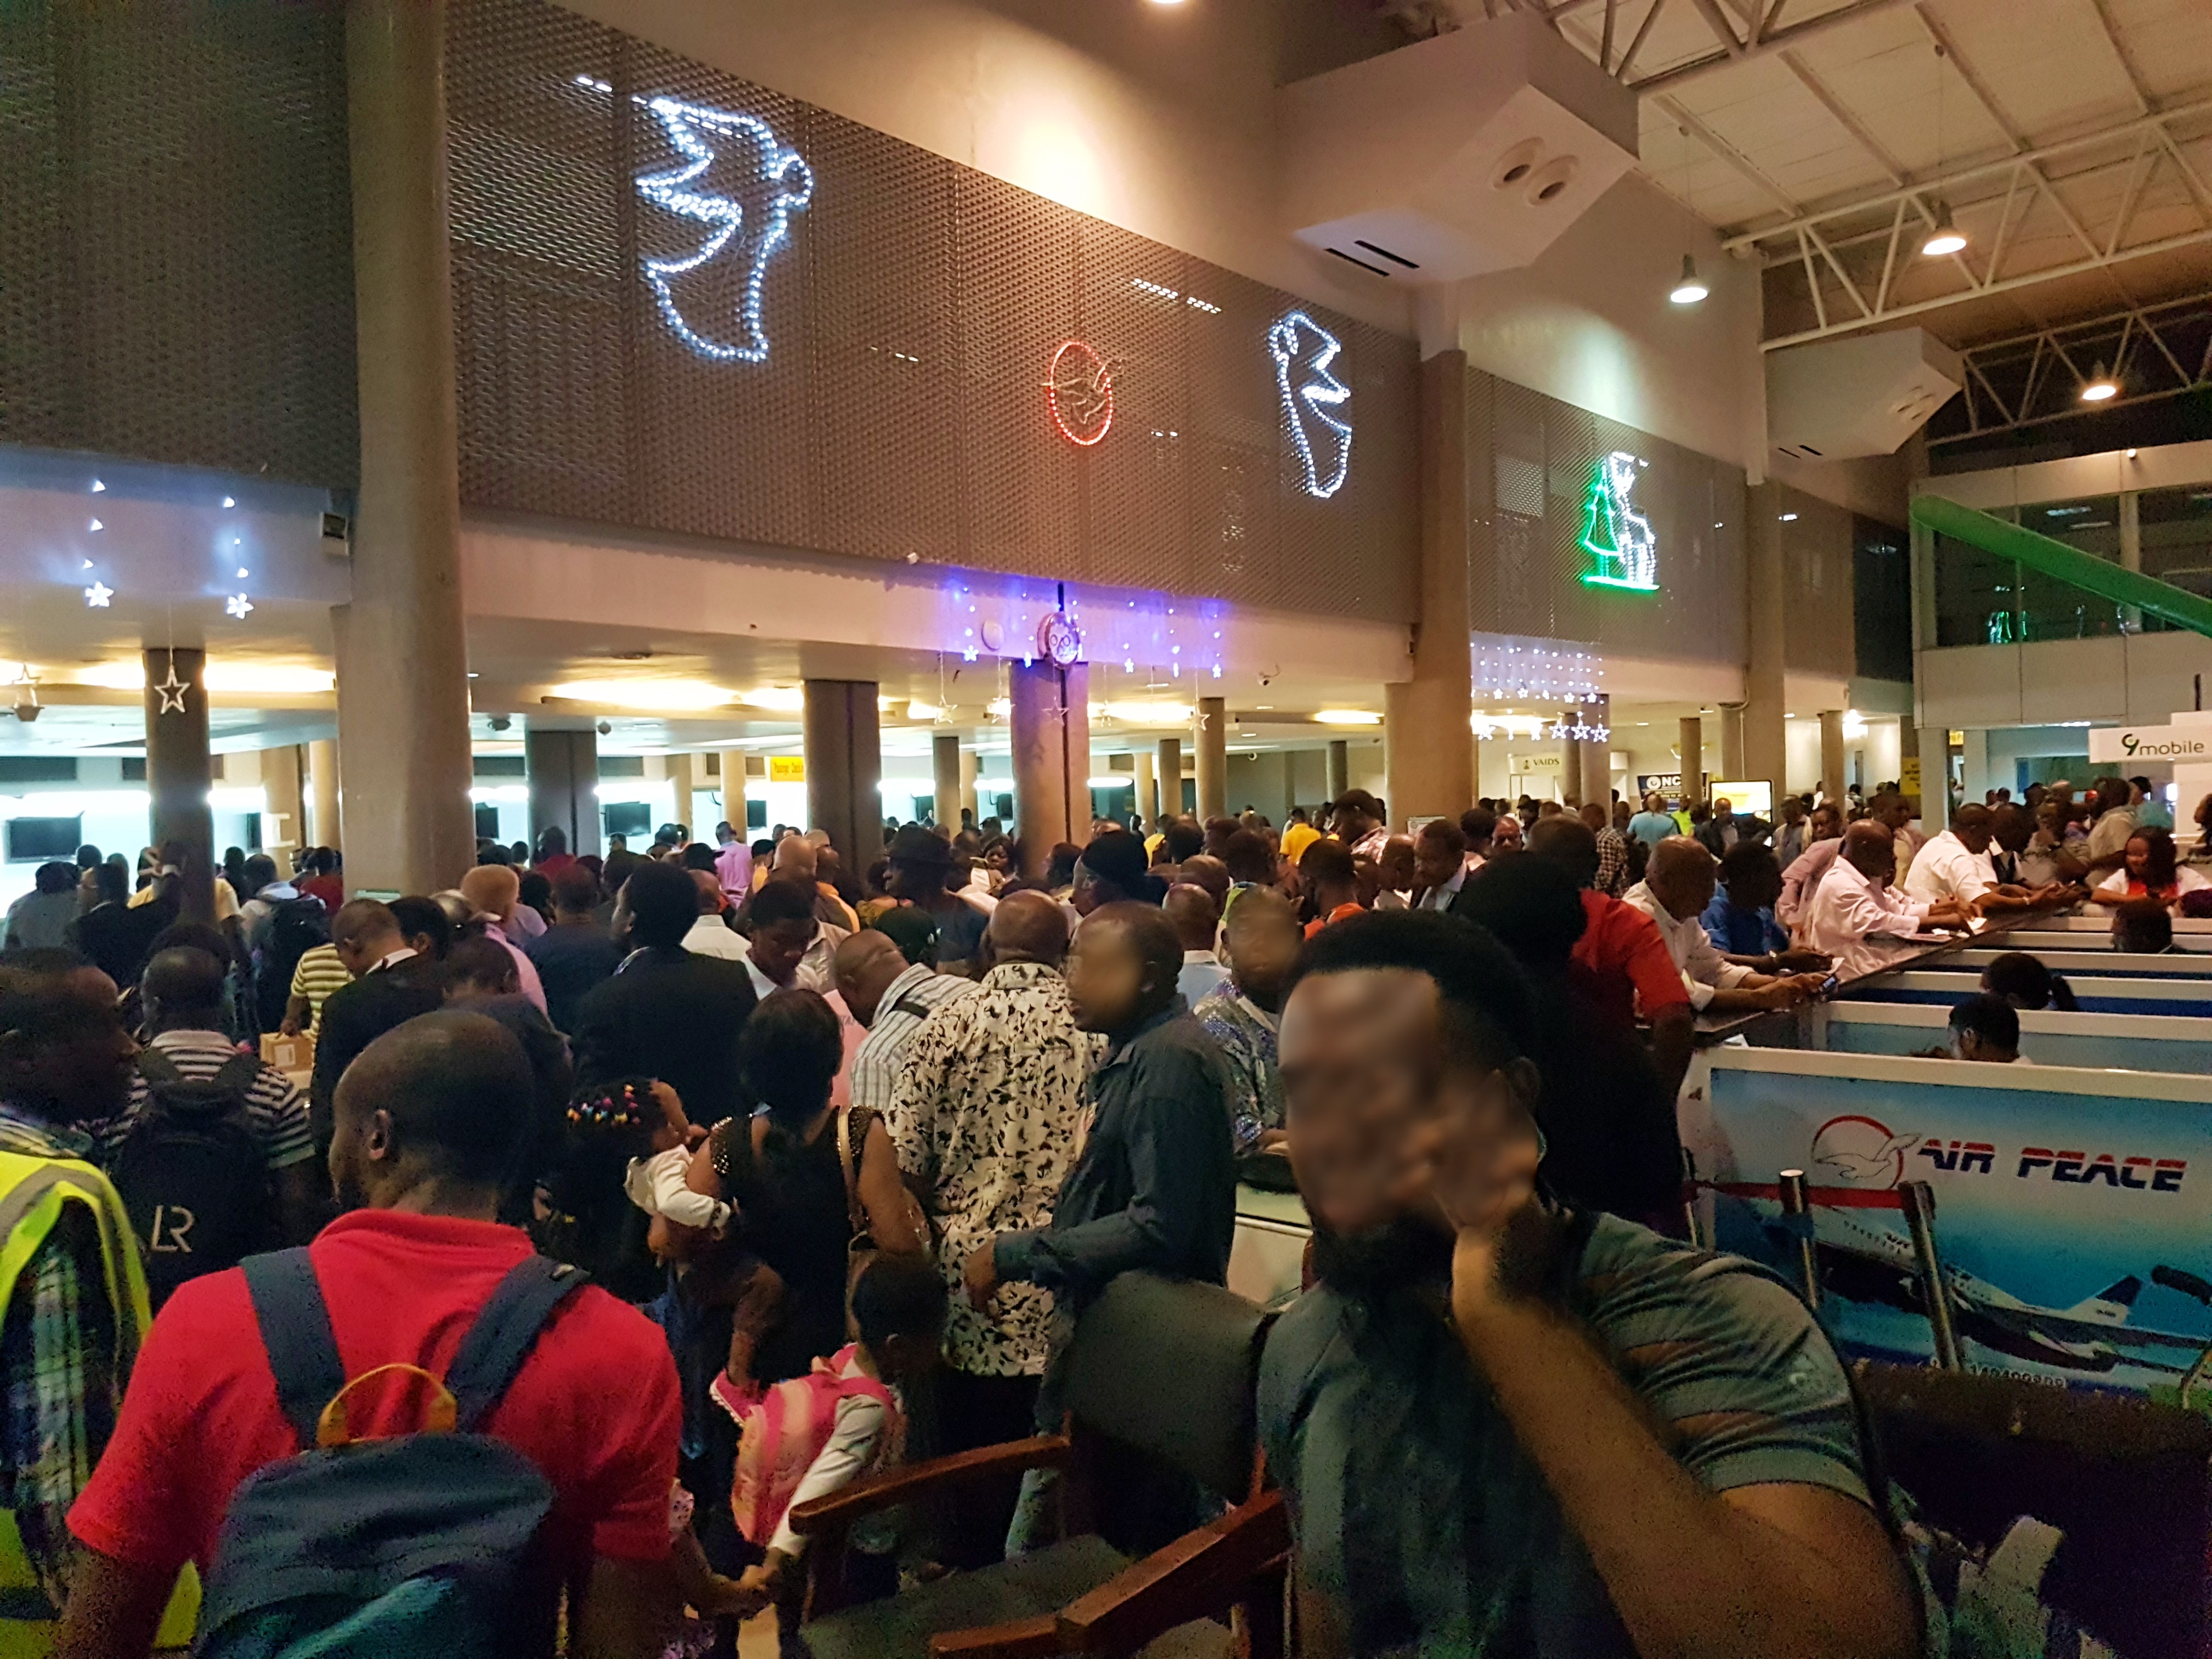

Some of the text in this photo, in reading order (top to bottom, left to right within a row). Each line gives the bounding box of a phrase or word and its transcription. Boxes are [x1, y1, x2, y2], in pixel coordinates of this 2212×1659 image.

[2121, 733, 2204, 756] 9mobile
[1662, 775, 1681, 787] NC
[1917, 1138, 2187, 1192] AIR PEACE
[151, 1205, 195, 1253] LR
